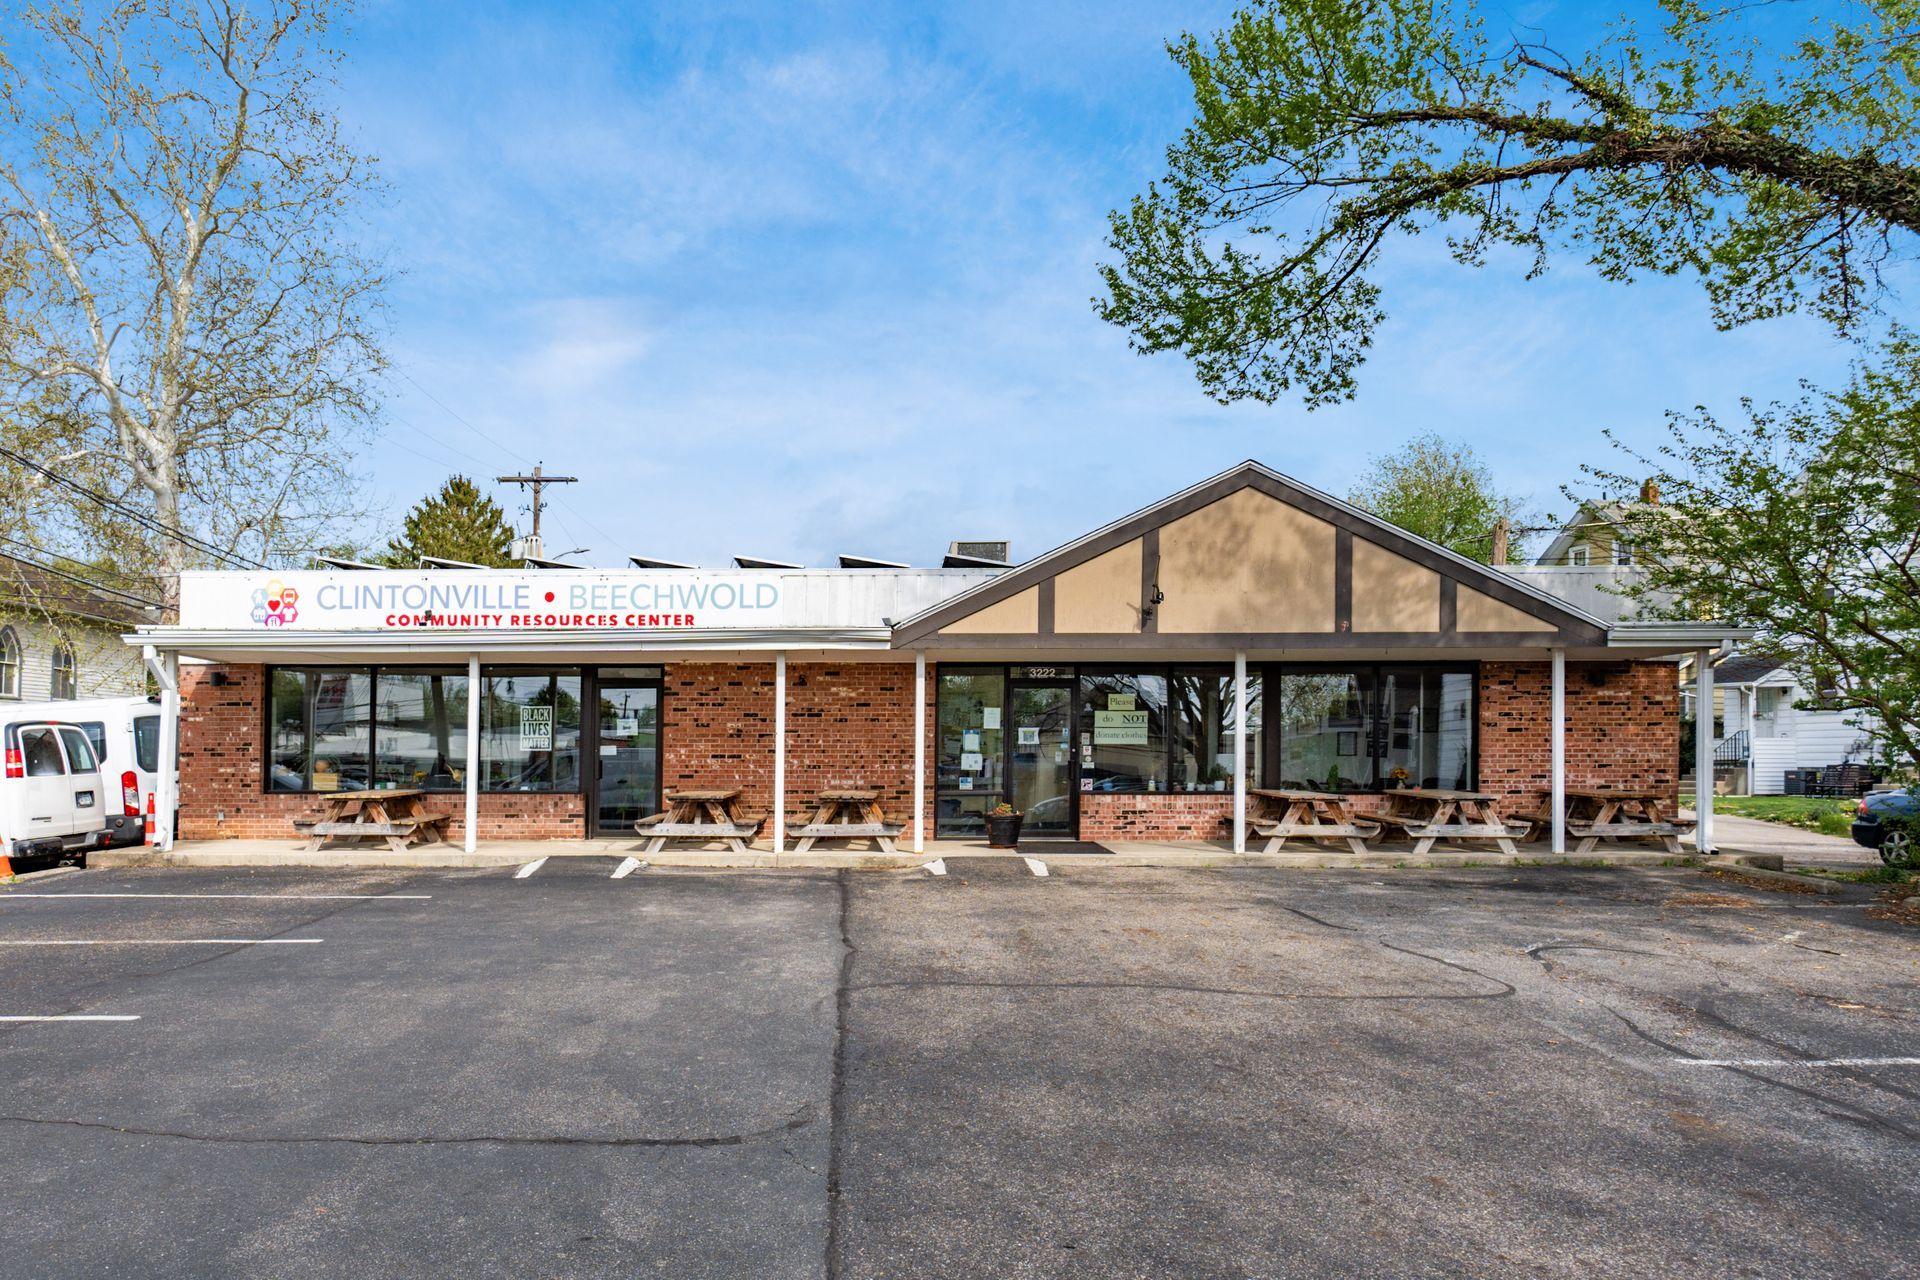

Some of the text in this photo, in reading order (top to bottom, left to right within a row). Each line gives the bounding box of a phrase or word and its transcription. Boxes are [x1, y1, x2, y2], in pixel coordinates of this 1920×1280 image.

[317, 583, 779, 610] CLINTONVILLE BEECHWOLD
[510, 614, 618, 626] RESOURCES
[625, 614, 695, 626] CENTER
[1030, 668, 1056, 678] 3222
[1110, 697, 1134, 706] Please
[523, 709, 549, 720] BLACK
[1103, 714, 1147, 724] do NOT
[523, 723, 549, 736] LIVES
[1095, 731, 1120, 739] donate
[523, 738, 549, 748] MATTER
